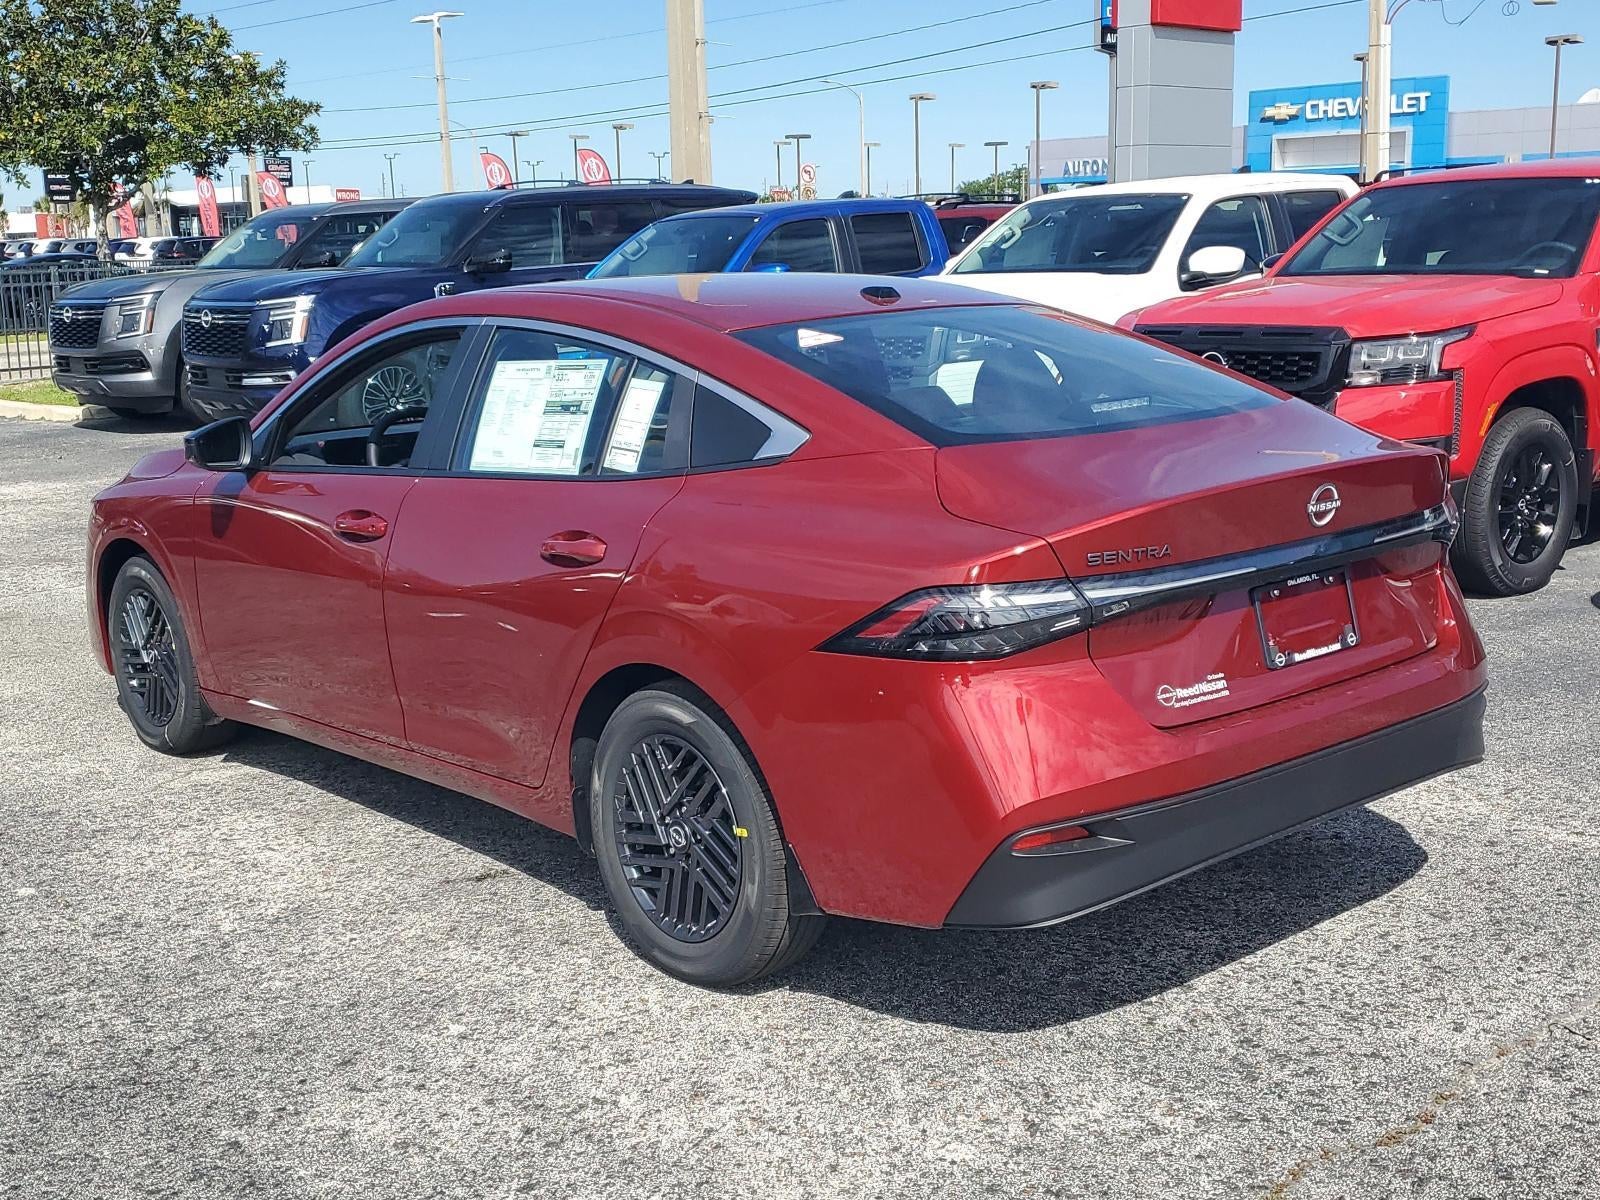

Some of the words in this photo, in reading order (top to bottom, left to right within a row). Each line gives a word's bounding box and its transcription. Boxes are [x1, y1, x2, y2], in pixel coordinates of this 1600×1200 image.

[1305, 91, 1431, 120] CHEVLET
[336, 191, 360, 200] WRONG
[1308, 500, 1341, 513] NISSAN
[1087, 544, 1172, 566] SENTRA
